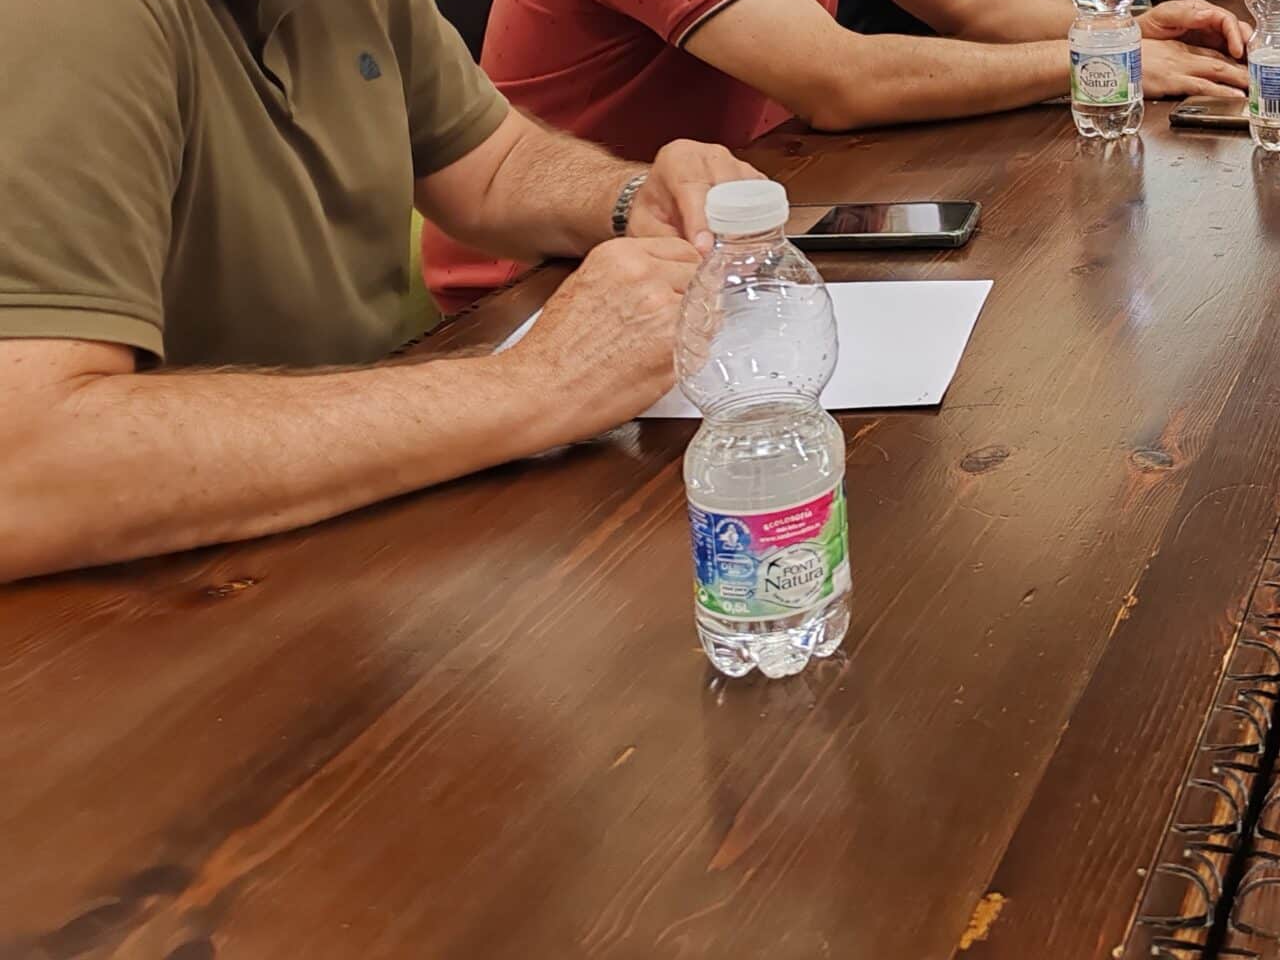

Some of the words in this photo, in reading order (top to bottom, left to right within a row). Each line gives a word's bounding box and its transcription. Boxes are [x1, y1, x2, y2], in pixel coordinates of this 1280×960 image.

[1080, 75, 1118, 88] Natura
[1088, 71, 1112, 80] FONT
[783, 558, 815, 577] FONT
[764, 567, 824, 593] Natura
